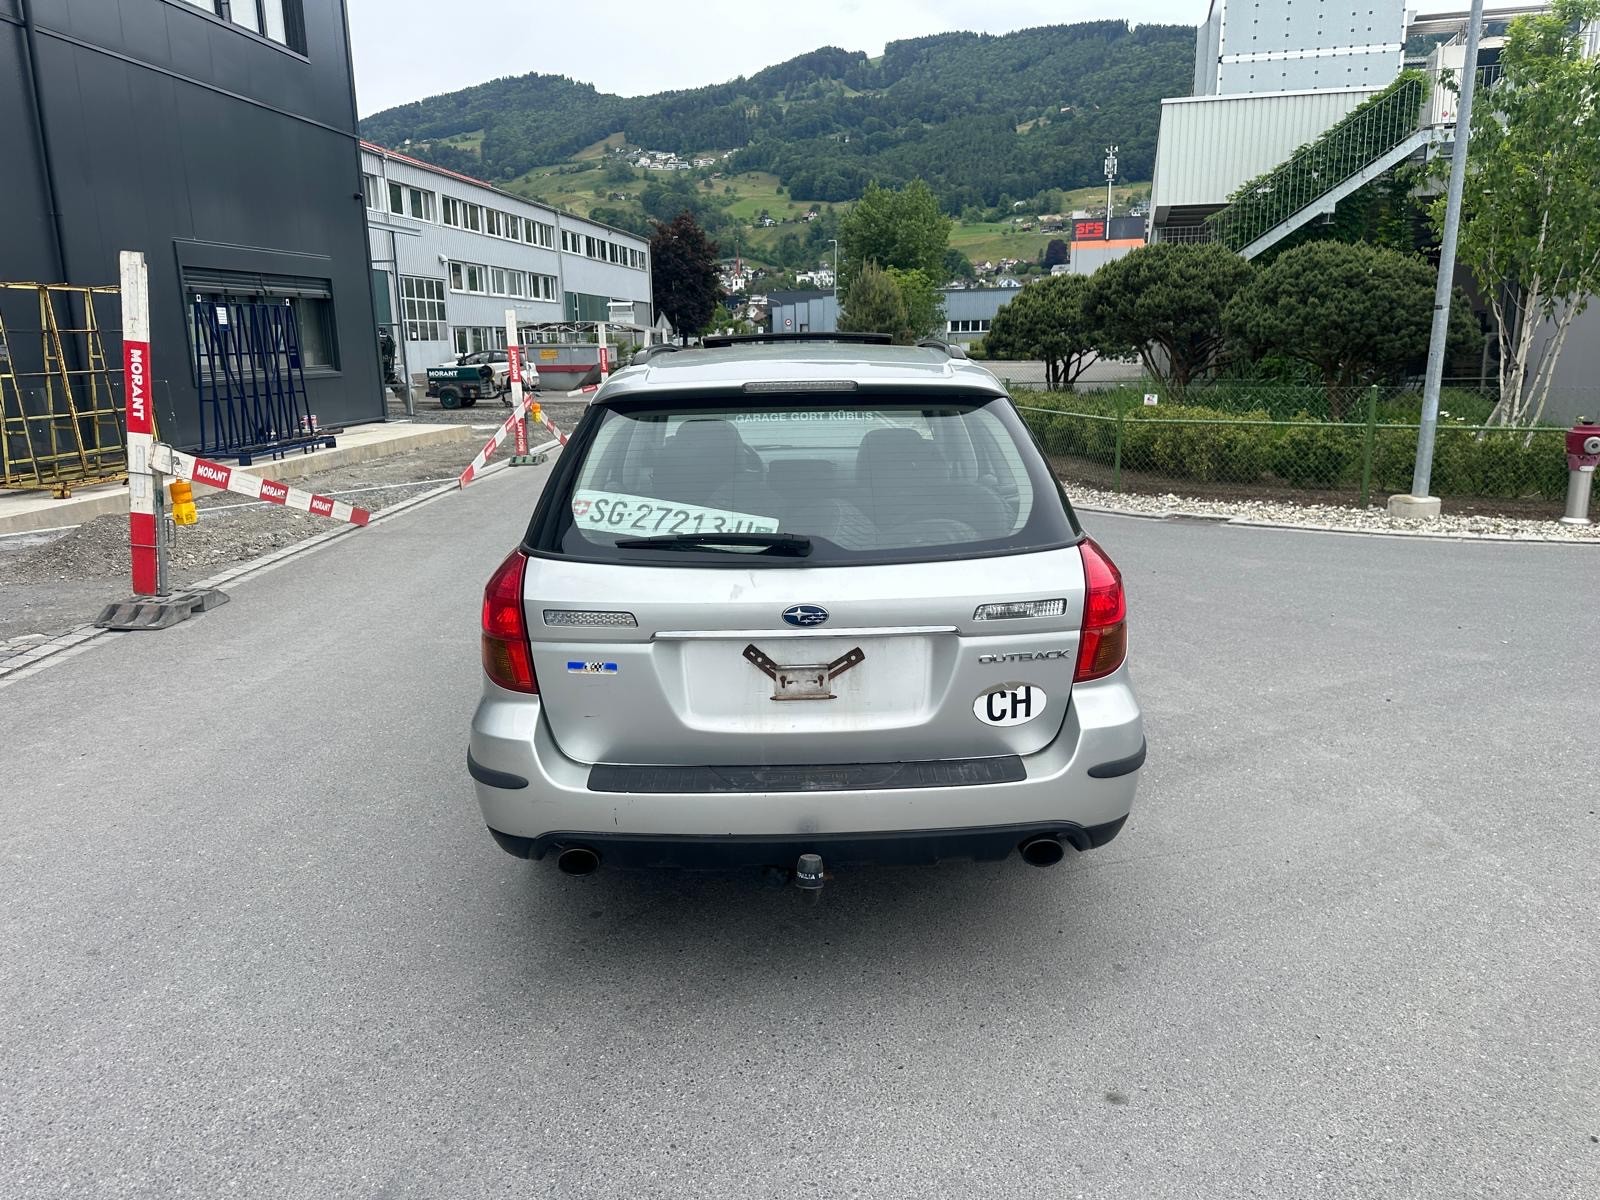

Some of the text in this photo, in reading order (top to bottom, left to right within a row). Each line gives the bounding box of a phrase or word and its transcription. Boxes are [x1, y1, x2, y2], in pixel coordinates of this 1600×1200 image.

[1076, 222, 1104, 237] SFS
[511, 350, 519, 380] MORANT
[130, 349, 145, 421] MORANT
[735, 409, 874, 423] GARAGE GORT KÜBLIS
[197, 464, 228, 483] MORANT
[262, 484, 286, 497] MORANT
[312, 499, 332, 512] MORANT
[978, 649, 1070, 664] OUTBACK
[986, 685, 1032, 722] CH
